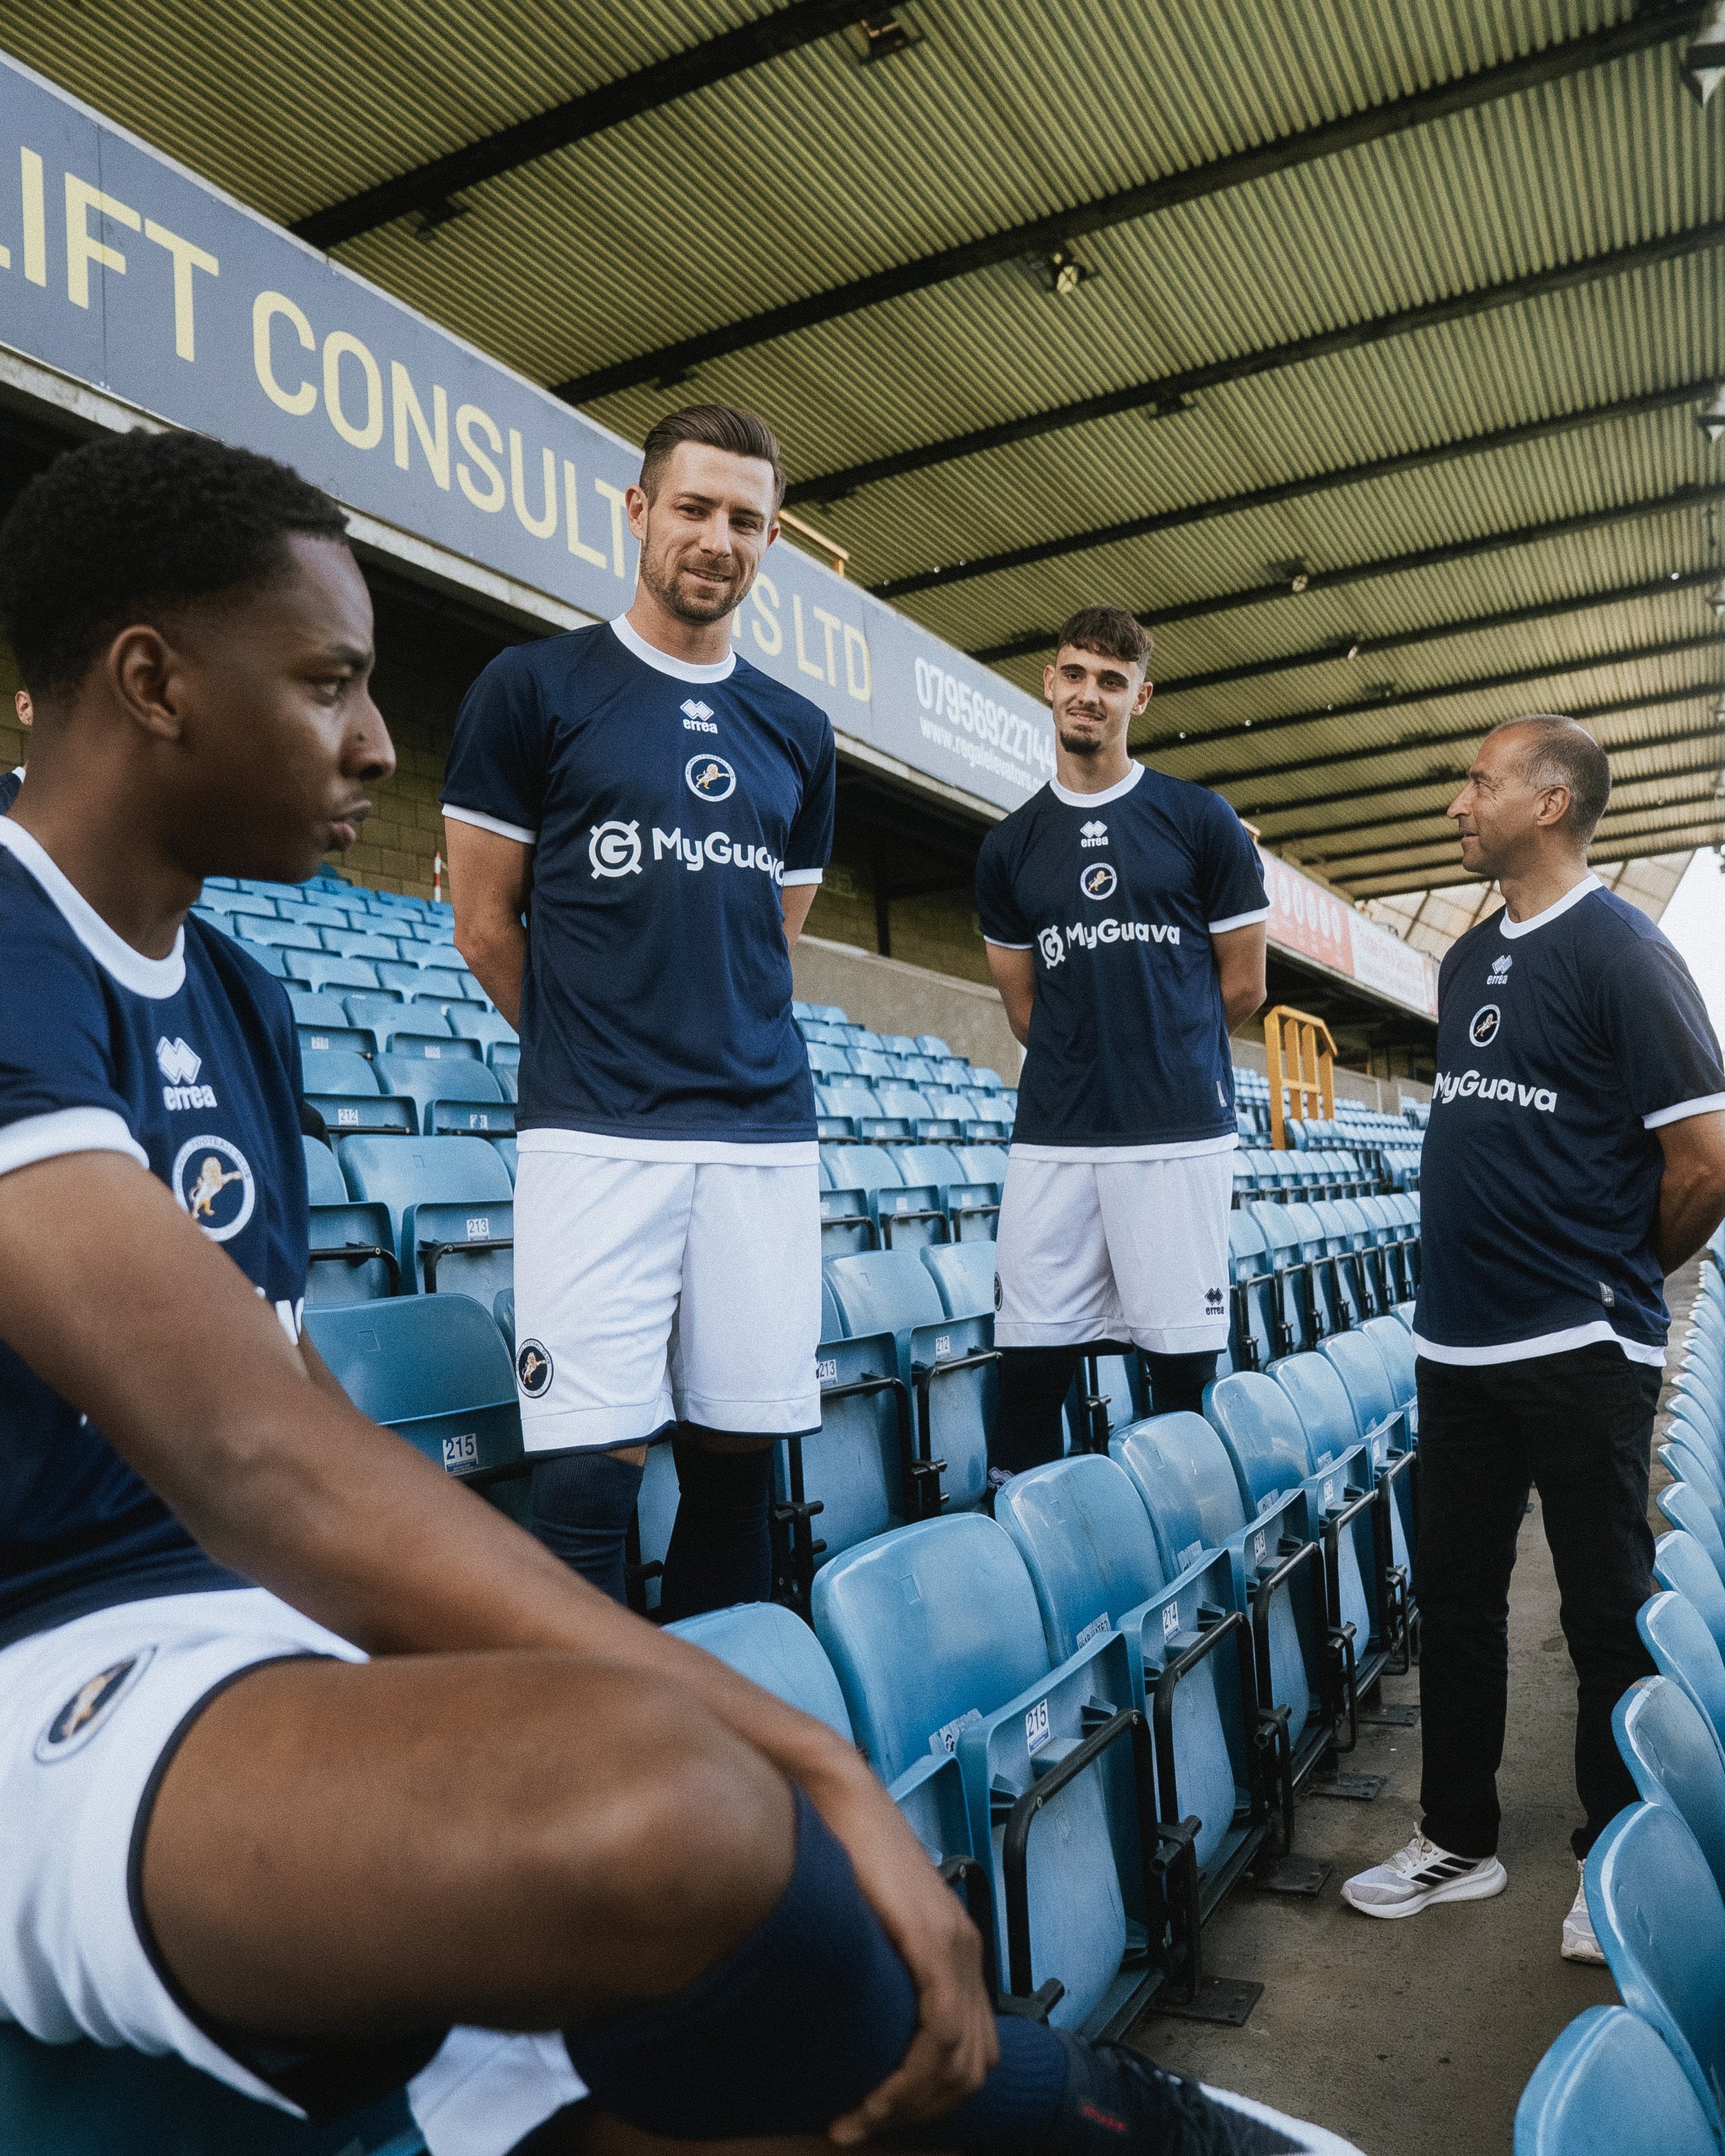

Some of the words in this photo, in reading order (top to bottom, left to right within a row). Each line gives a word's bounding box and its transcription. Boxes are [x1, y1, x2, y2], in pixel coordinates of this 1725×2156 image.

[0, 146, 219, 362] IFT
[253, 290, 783, 656] CONSULTS
[792, 594, 872, 702] LTD
[1066, 918, 1180, 949] MyGuava
[1432, 1070, 1557, 1113] MyGuava
[340, 1109, 357, 1120] 212
[469, 1220, 487, 1233] 213
[937, 1337, 948, 1352] 212
[819, 1361, 835, 1377] 213
[446, 1435, 475, 1460] 215
[1163, 1603, 1176, 1629] 214
[1027, 1701, 1047, 1738] 215
